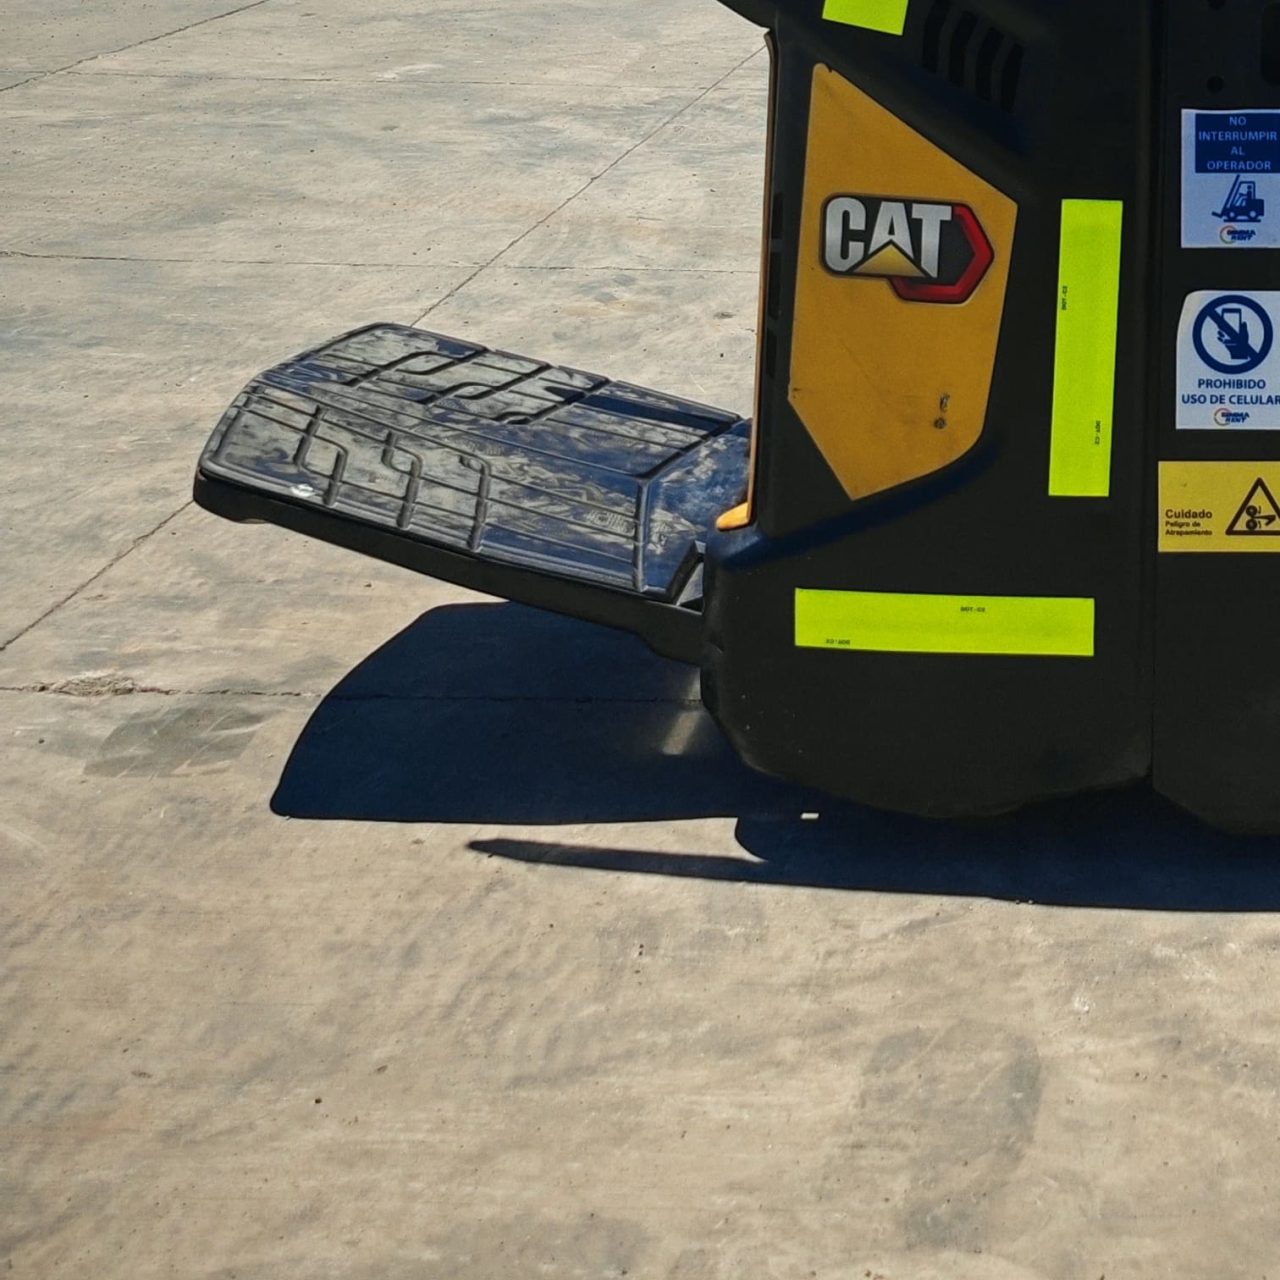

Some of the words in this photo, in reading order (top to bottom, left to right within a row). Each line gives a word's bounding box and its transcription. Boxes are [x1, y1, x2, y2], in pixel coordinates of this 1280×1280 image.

[1229, 116, 1247, 126] NO
[1198, 131, 1277, 141] INTERRUMPIR
[1230, 146, 1245, 156] AL
[1207, 160, 1271, 170] OPERADOR
[825, 196, 953, 279] CAT
[1198, 378, 1266, 389] PROHIBIDO
[1181, 394, 1207, 405] USO
[1210, 394, 1226, 405] DE
[1165, 509, 1212, 519] Cuidado
[1165, 521, 1190, 529] Peligro
